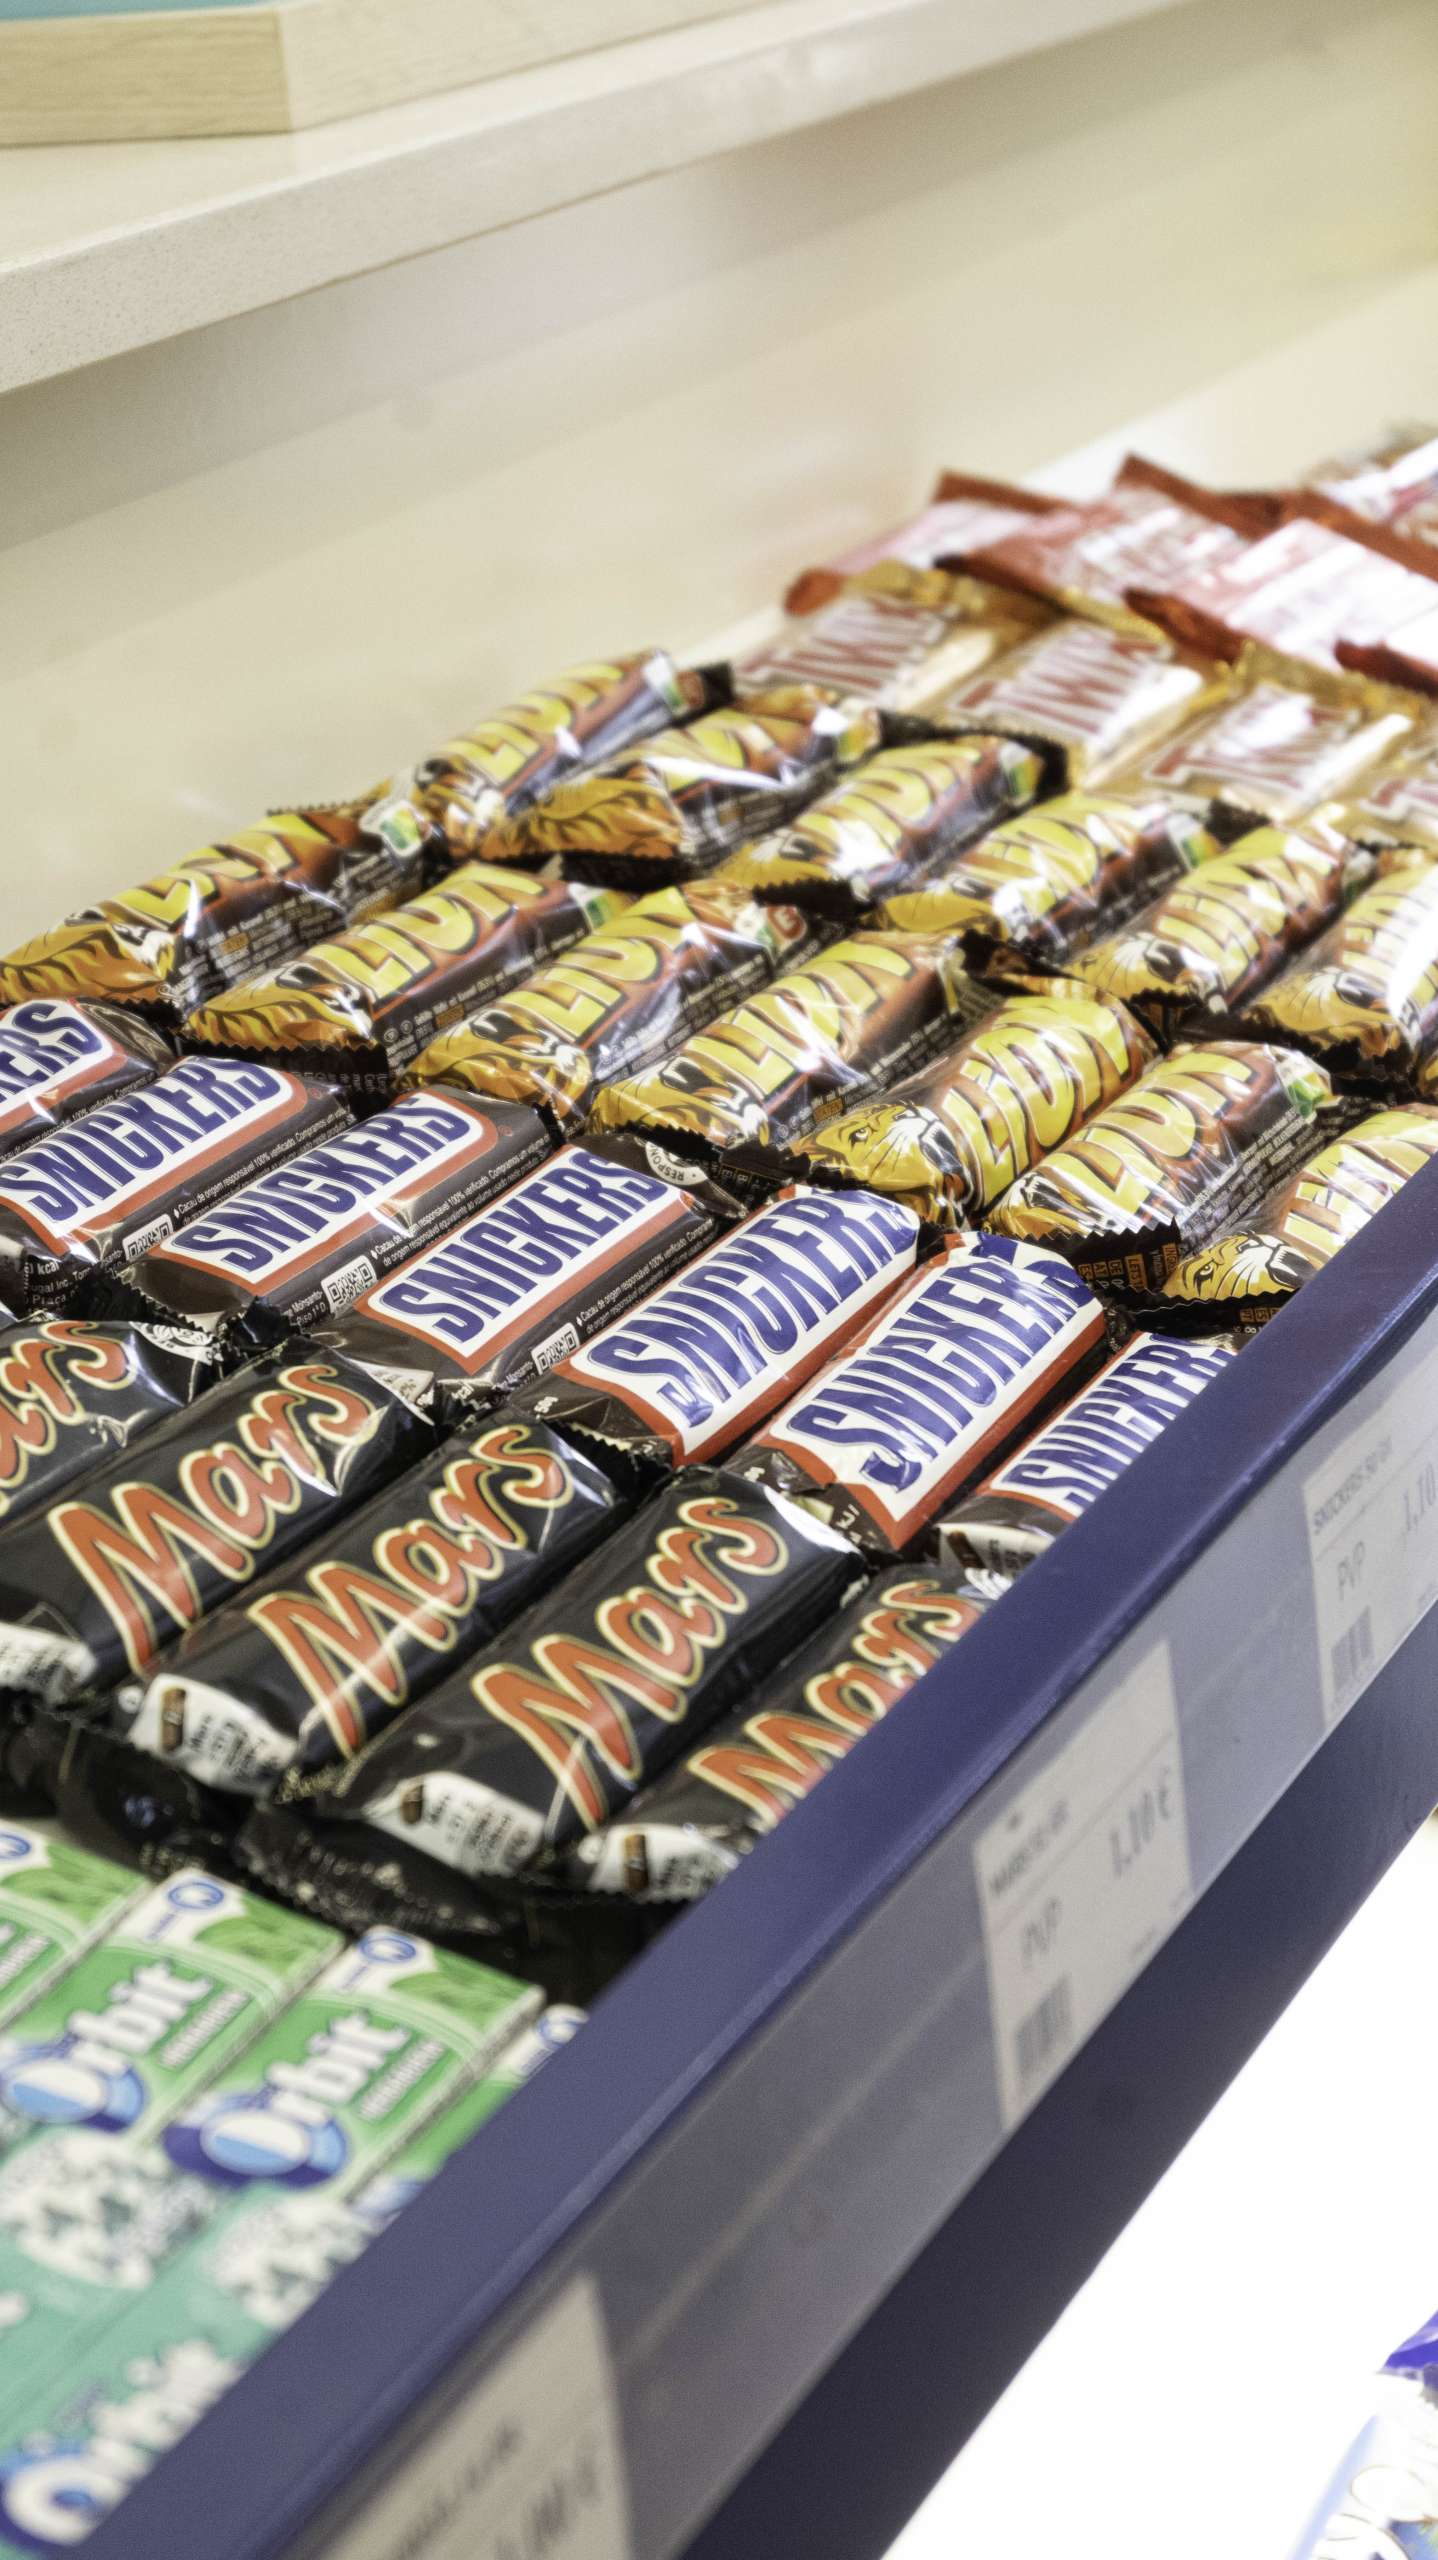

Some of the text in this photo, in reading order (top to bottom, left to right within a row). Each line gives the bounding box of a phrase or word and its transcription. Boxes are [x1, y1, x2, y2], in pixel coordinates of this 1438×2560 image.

[302, 861, 547, 1000] LION
[685, 937, 916, 1097] LION
[939, 996, 1132, 1202] LION
[0, 1056, 281, 1222] SNICKERS
[171, 1096, 471, 1273] SNICKERS
[253, 1152, 270, 1166] 100%
[448, 1190, 465, 1205] 100%
[1035, 1051, 1256, 1218] LION
[380, 1151, 669, 1343] SNICKERS
[648, 1254, 665, 1269] 100%
[0, 1320, 138, 1490] ars
[48, 1365, 380, 1675] Mars
[247, 1426, 574, 1757] Mars
[470, 1496, 789, 1833] Mars
[688, 1580, 987, 1832] Mars
[200, 2006, 410, 2176] Orbit
